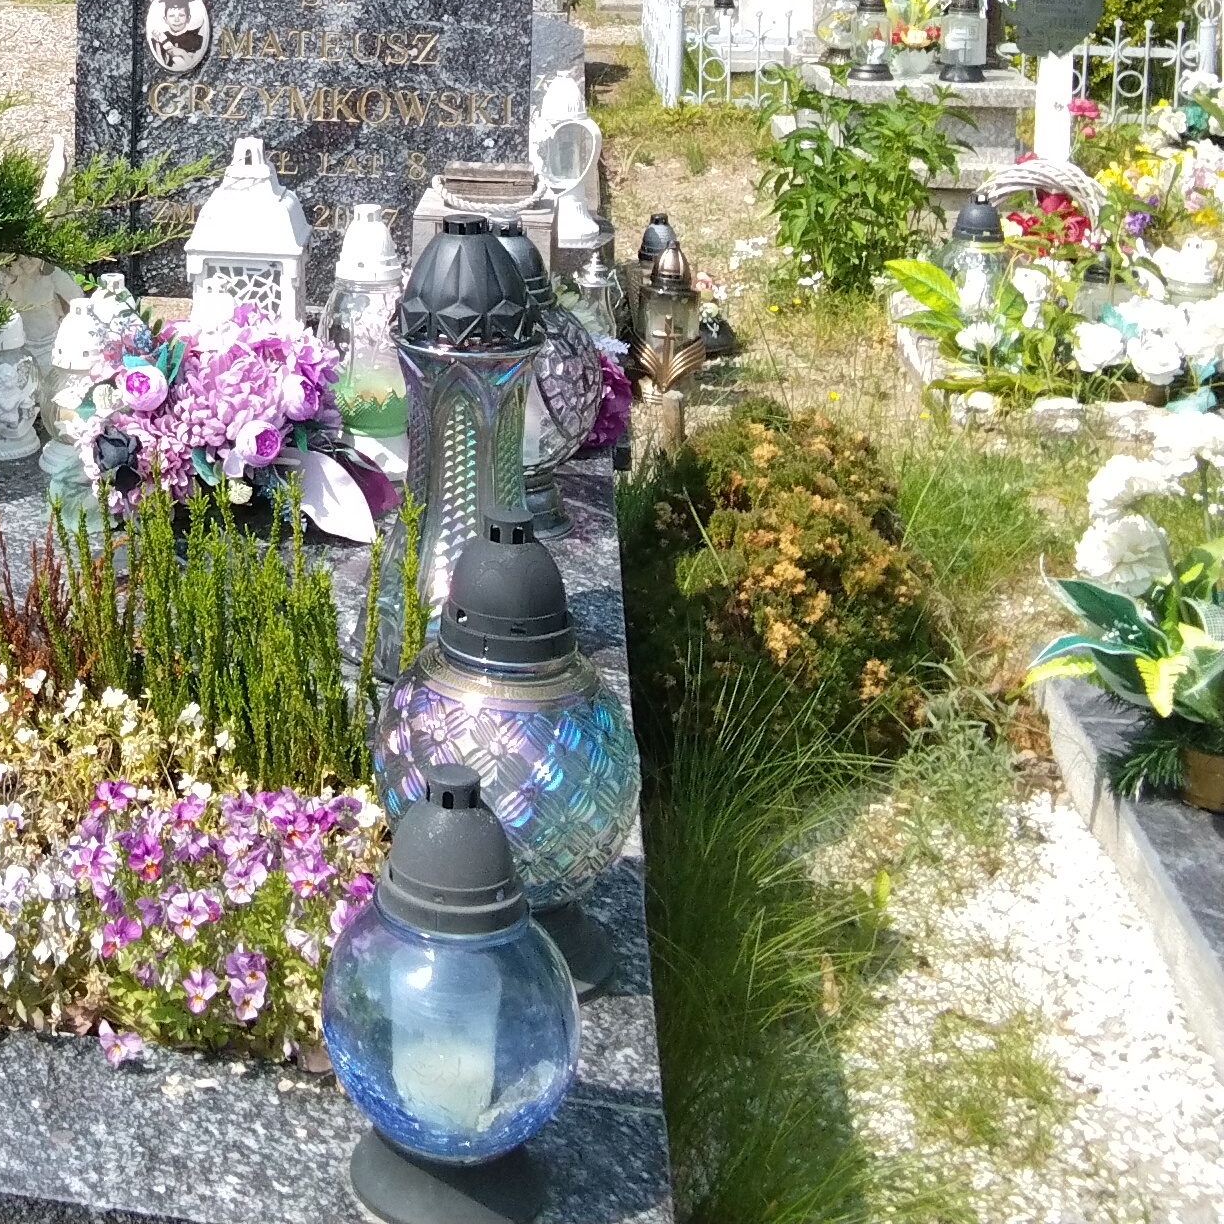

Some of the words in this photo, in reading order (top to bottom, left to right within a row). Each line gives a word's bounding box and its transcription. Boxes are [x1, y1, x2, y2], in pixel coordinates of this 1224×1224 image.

[219, 25, 440, 65] MATEUSZ
[148, 82, 514, 128] GRZYMKOWSKI
[318, 152, 384, 178] LAT
[407, 151, 428, 180] 8
